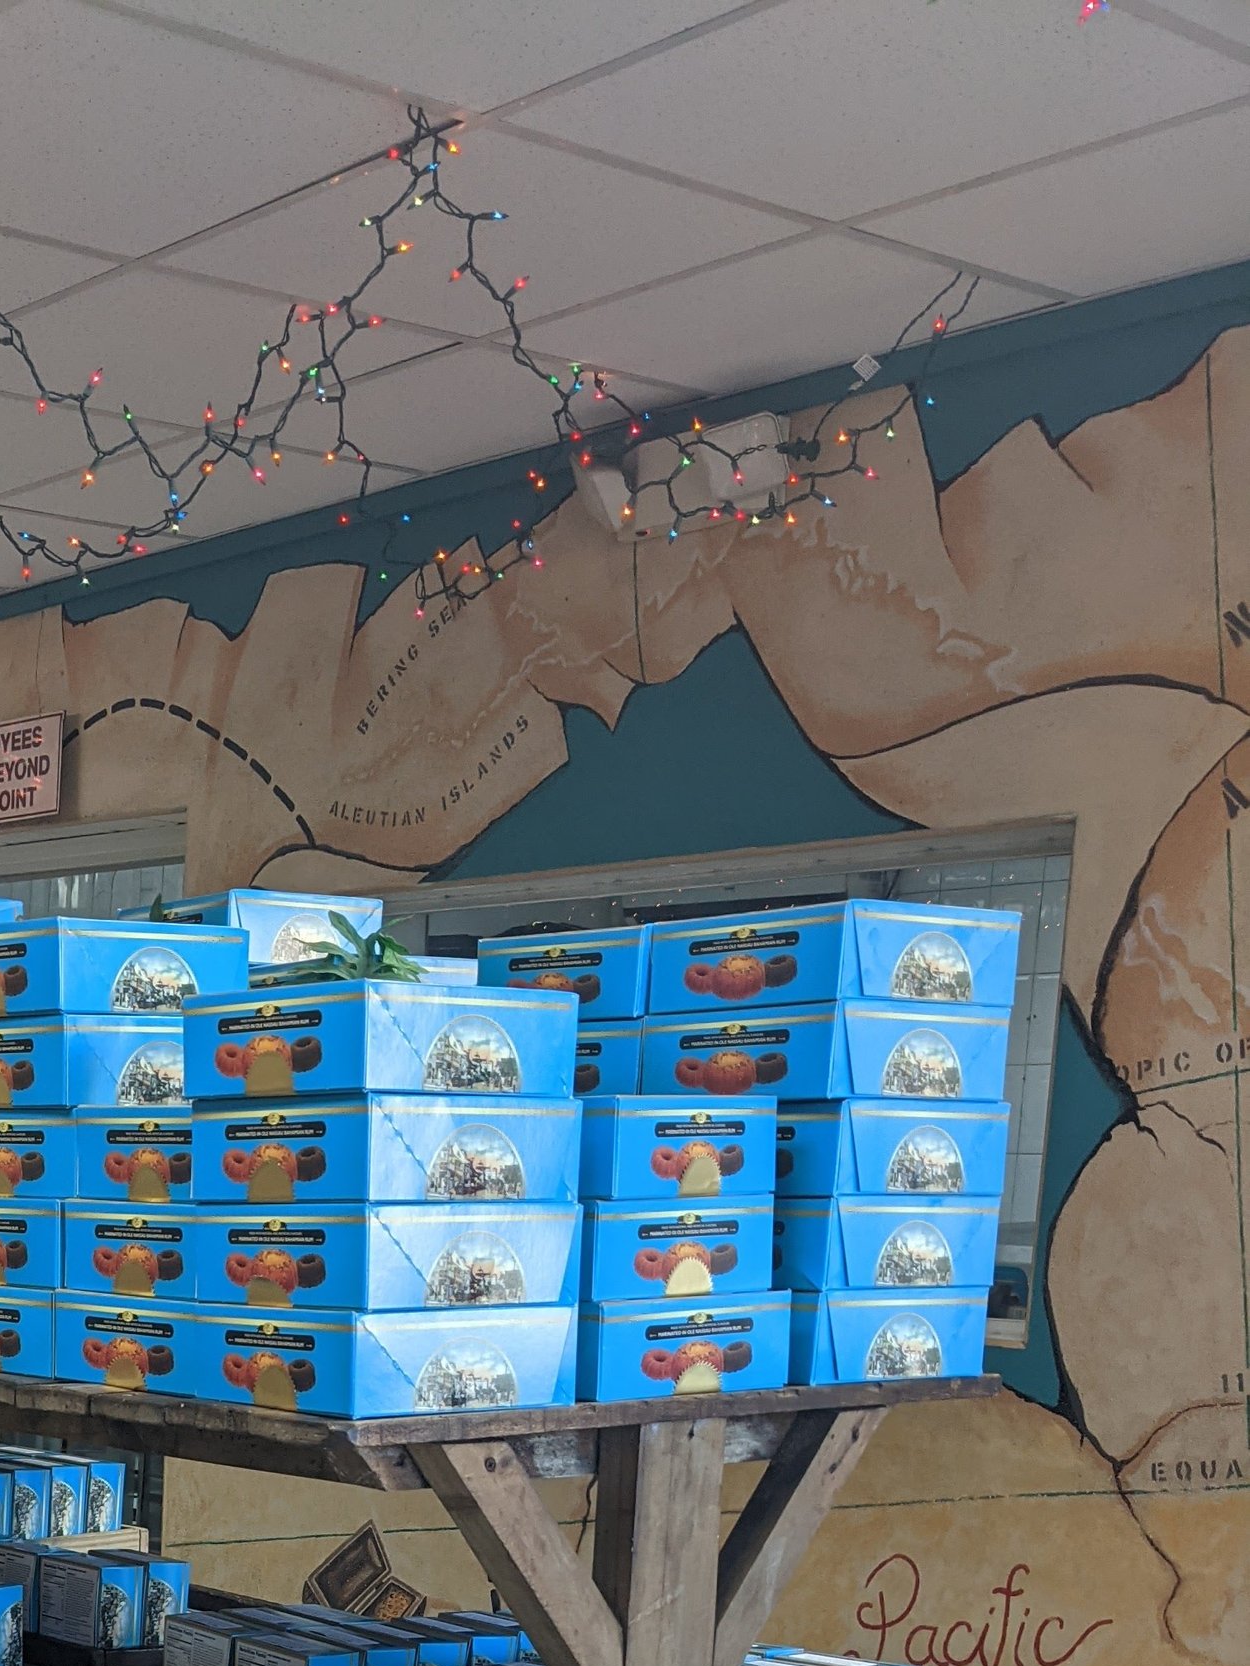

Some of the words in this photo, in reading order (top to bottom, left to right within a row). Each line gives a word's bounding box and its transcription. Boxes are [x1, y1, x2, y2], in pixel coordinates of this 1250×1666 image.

[357, 644, 418, 735] BERING
[428, 598, 467, 638] SEA
[330, 800, 425, 827] ALEUTIAN
[441, 715, 529, 810] ISLANDS
[1151, 1457, 1243, 1482] EQUA
